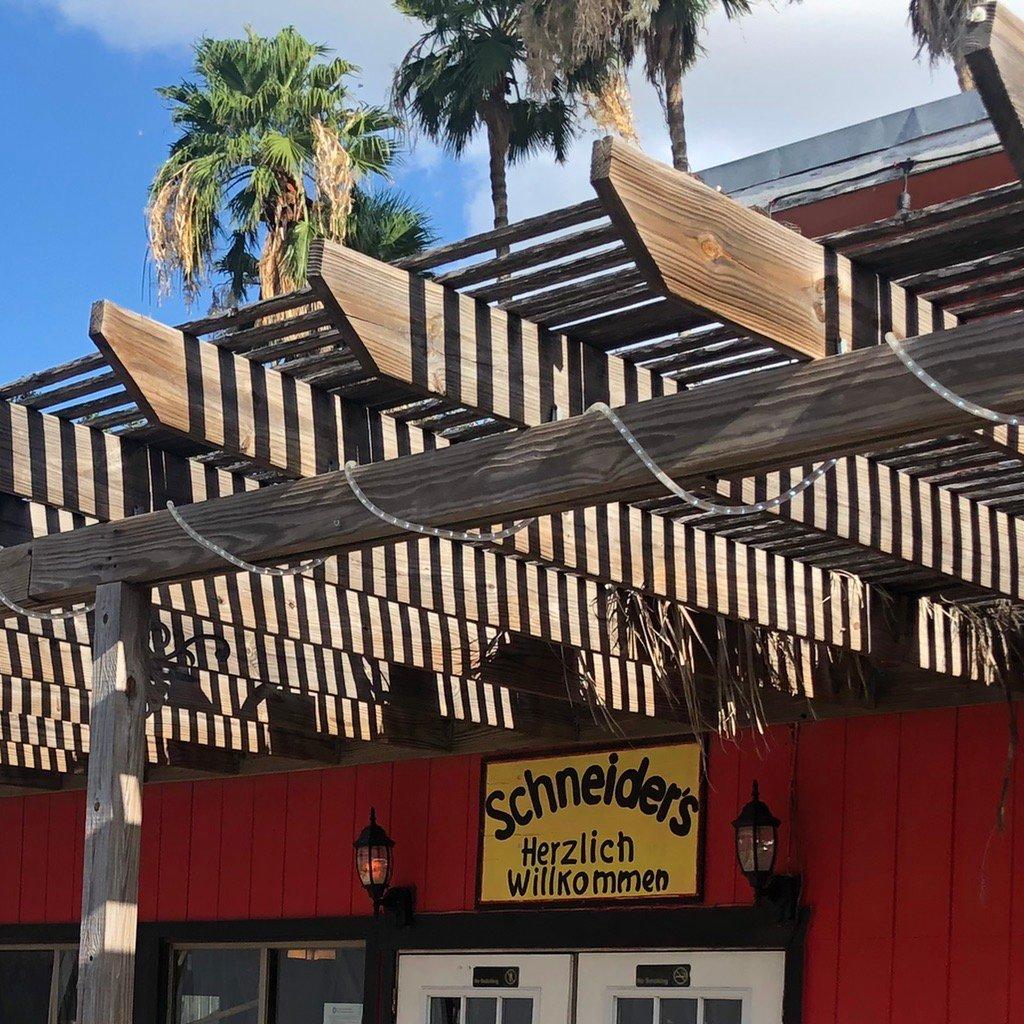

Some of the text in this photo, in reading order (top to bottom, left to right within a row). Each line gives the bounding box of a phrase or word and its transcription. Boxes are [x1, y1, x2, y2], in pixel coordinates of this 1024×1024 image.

[485, 752, 699, 841] Schneider's
[522, 830, 635, 866] Herzlich
[508, 866, 669, 897] Willkommen
